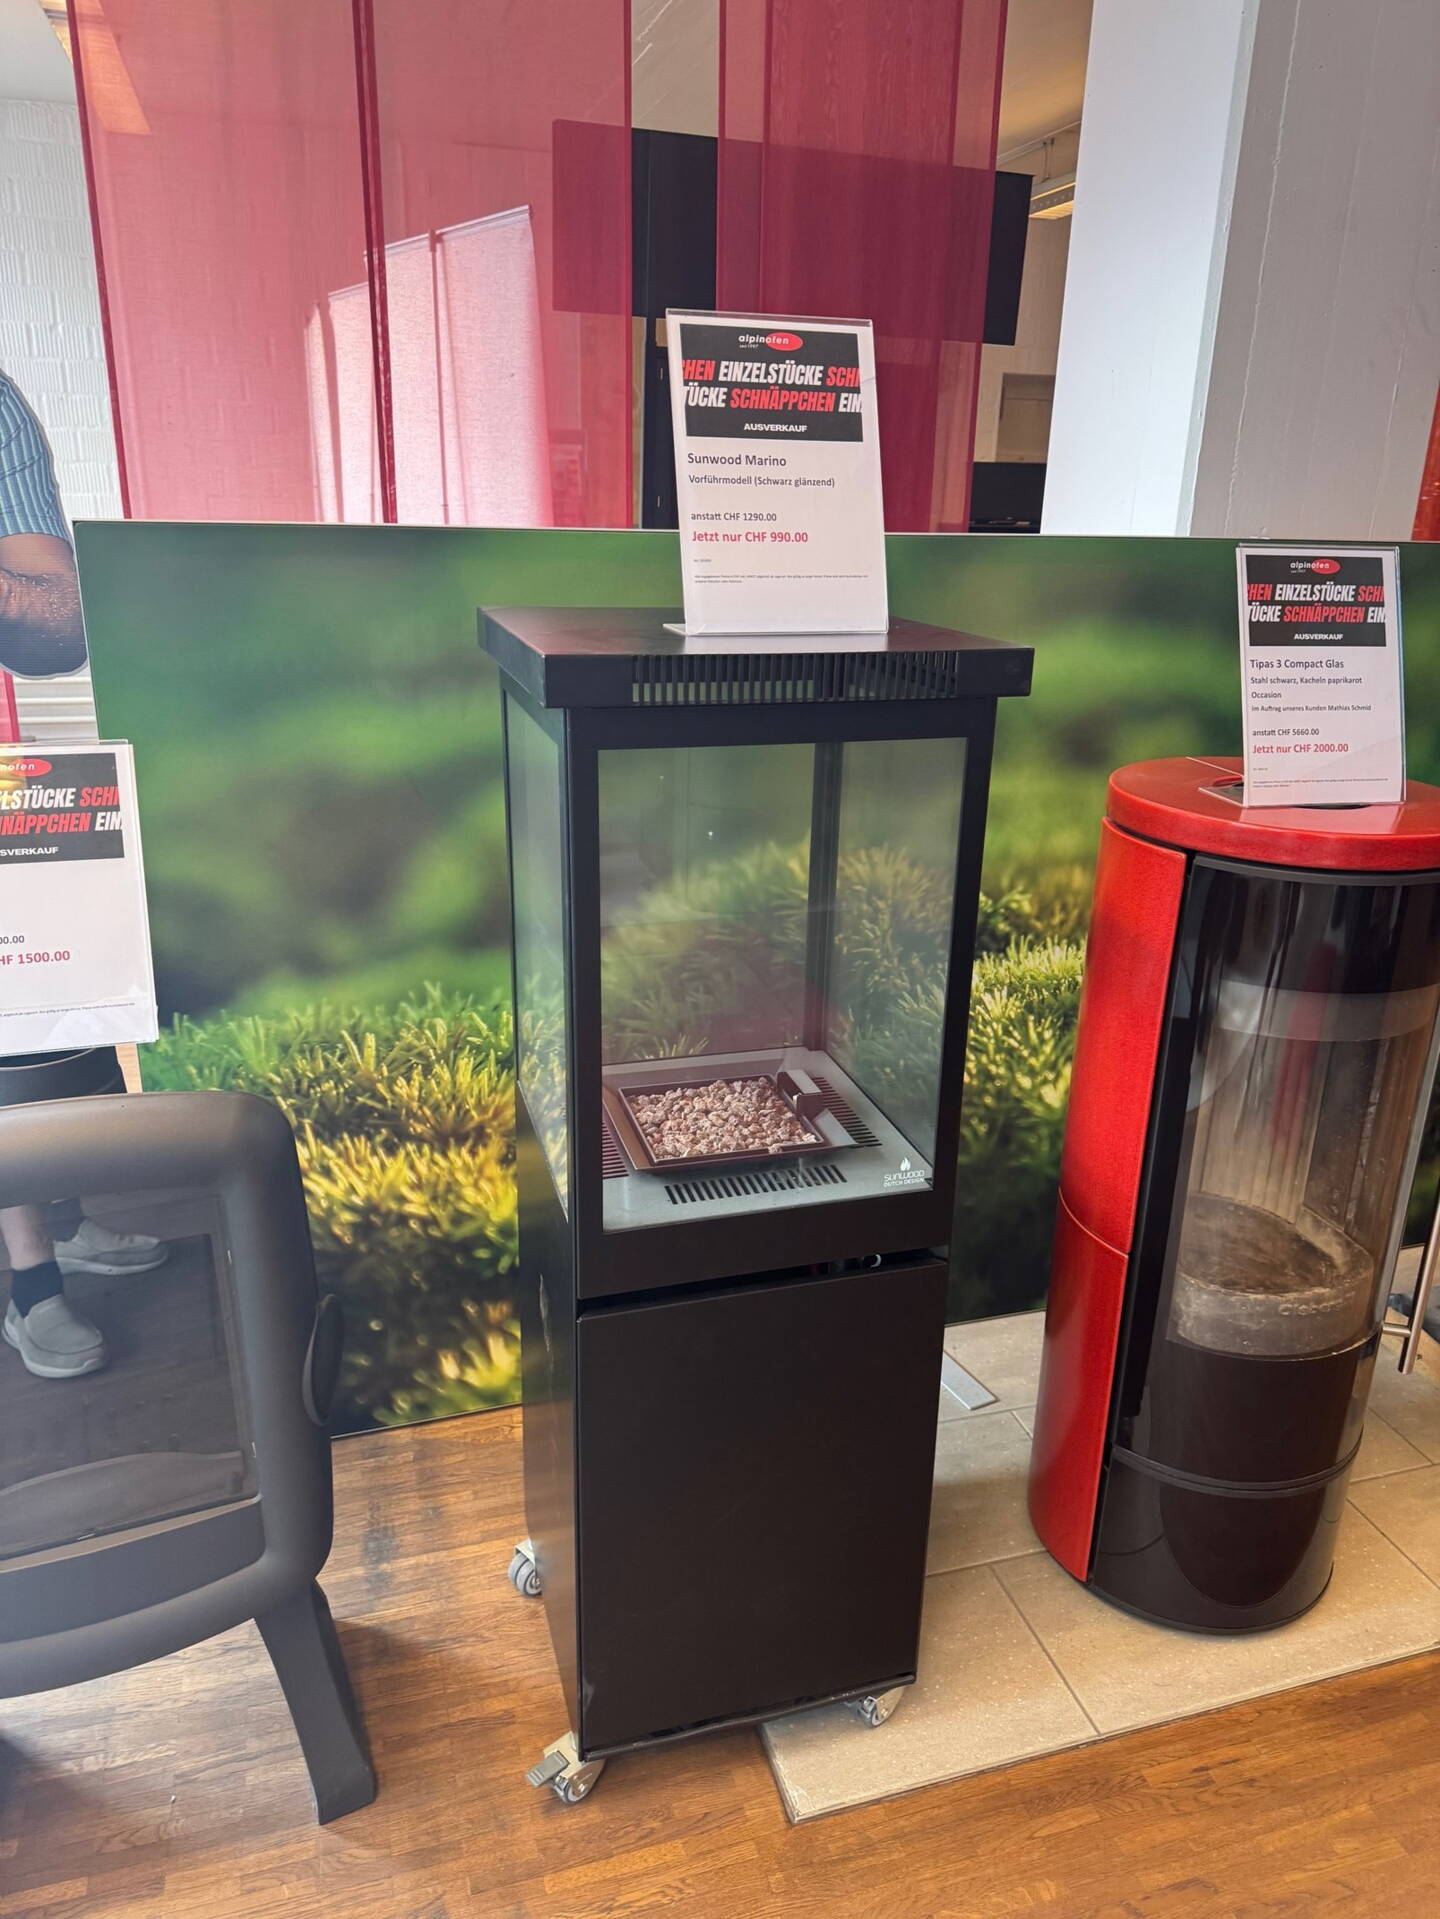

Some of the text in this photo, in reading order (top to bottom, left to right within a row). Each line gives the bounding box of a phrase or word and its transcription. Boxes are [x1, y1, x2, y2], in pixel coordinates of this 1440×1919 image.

[738, 334, 789, 345] alpinofen
[682, 359, 715, 380] HEN
[718, 360, 824, 386] EINZELSTÜCKE
[730, 385, 836, 412] SCHNÄPPCHEN
[838, 392, 863, 413] EIN
[743, 423, 808, 433] AUSVERKAUF
[687, 453, 787, 467] Sunwood Marino
[688, 474, 835, 488] Vorführmodell (Schwarz glänzend)
[691, 512, 777, 522] anstatt CHF 1290.00
[692, 531, 808, 543] Jetzt nur CHF 990.00
[1290, 561, 1330, 570] alpinofen
[1247, 583, 1273, 600] HEN
[1274, 581, 1356, 602] EINZELSTÜCKE
[1284, 603, 1365, 623] SCHNÄPPCHEN
[1367, 606, 1387, 623] EIN
[1250, 659, 1344, 670] Tipas 3 Compact Glas
[1270, 677, 1299, 685] schwarz,
[1328, 677, 1362, 685] paprikarot
[1251, 691, 1282, 699] Occasion
[1292, 728, 1320, 736] 5660.00
[1252, 743, 1349, 754] Jetzt nur CHF 2000.00
[95, 811, 123, 831] EIN
[18, 950, 71, 965] 1500.00
